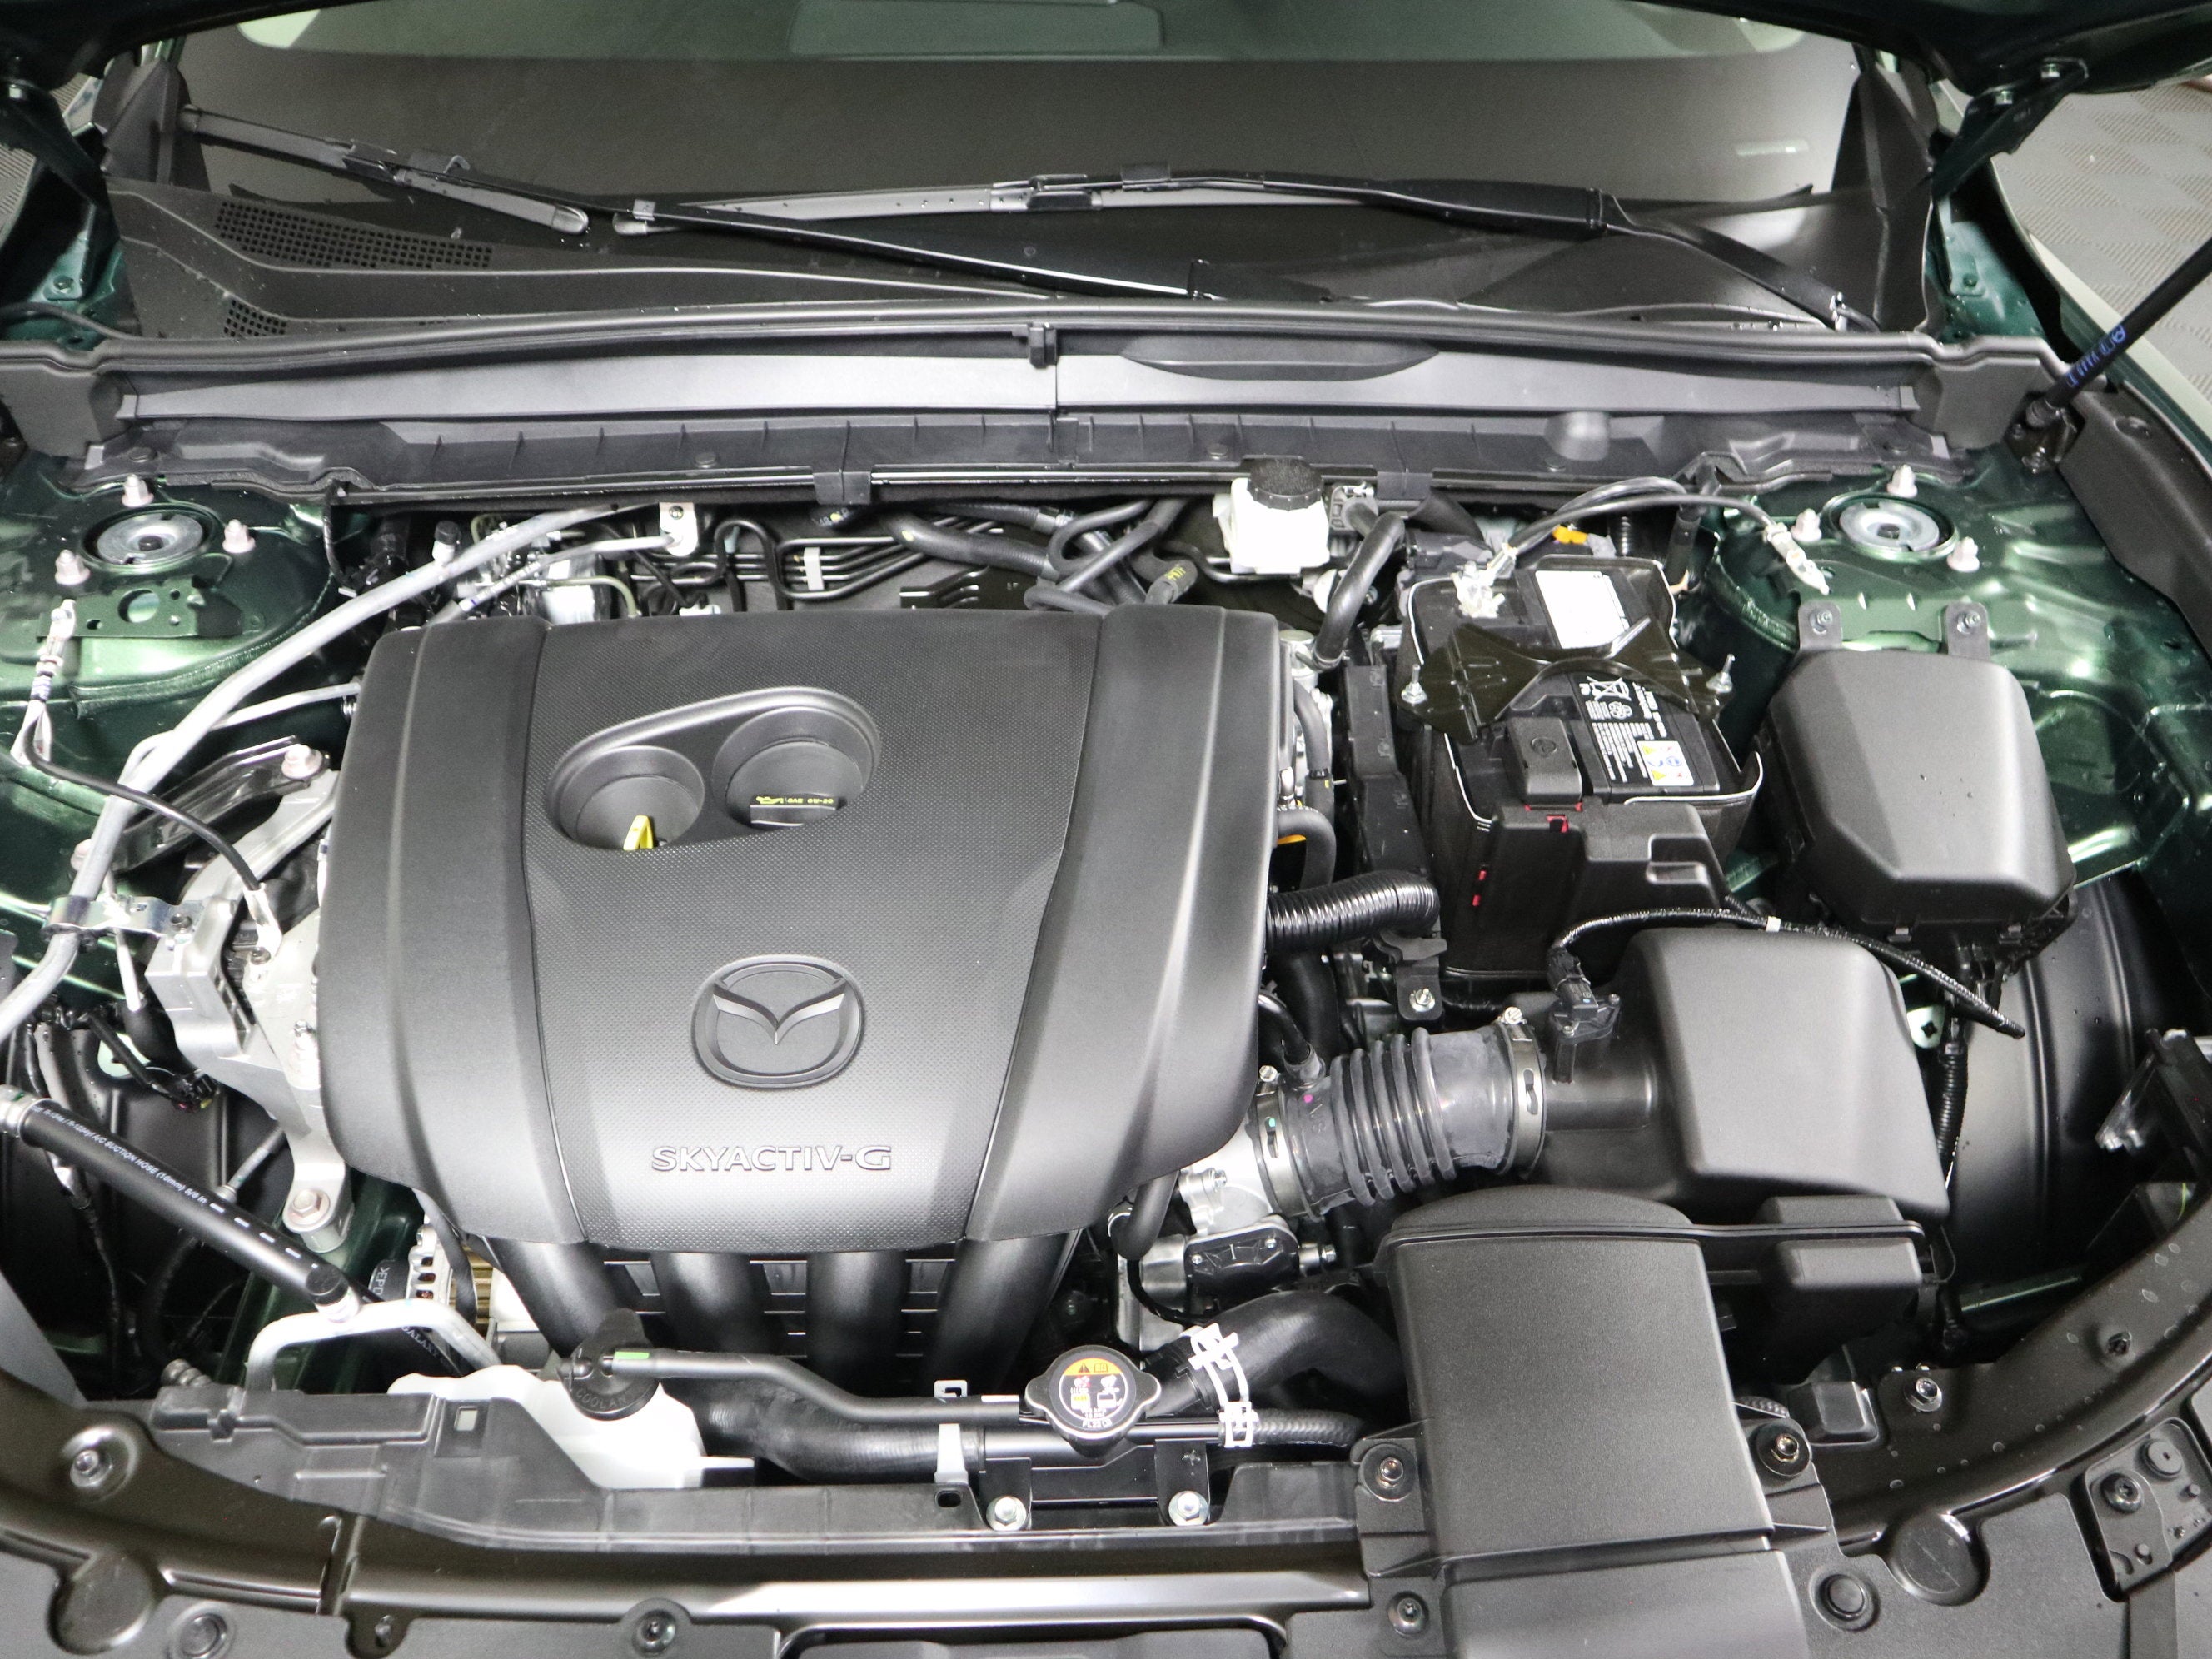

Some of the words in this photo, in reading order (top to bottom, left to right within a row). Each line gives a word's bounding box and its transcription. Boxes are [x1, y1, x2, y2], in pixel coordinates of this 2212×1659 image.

[104, 1140, 137, 1163] SUCTION
[135, 1157, 159, 1175] HOSE
[651, 1146, 893, 1172] SKYACTIV-G
